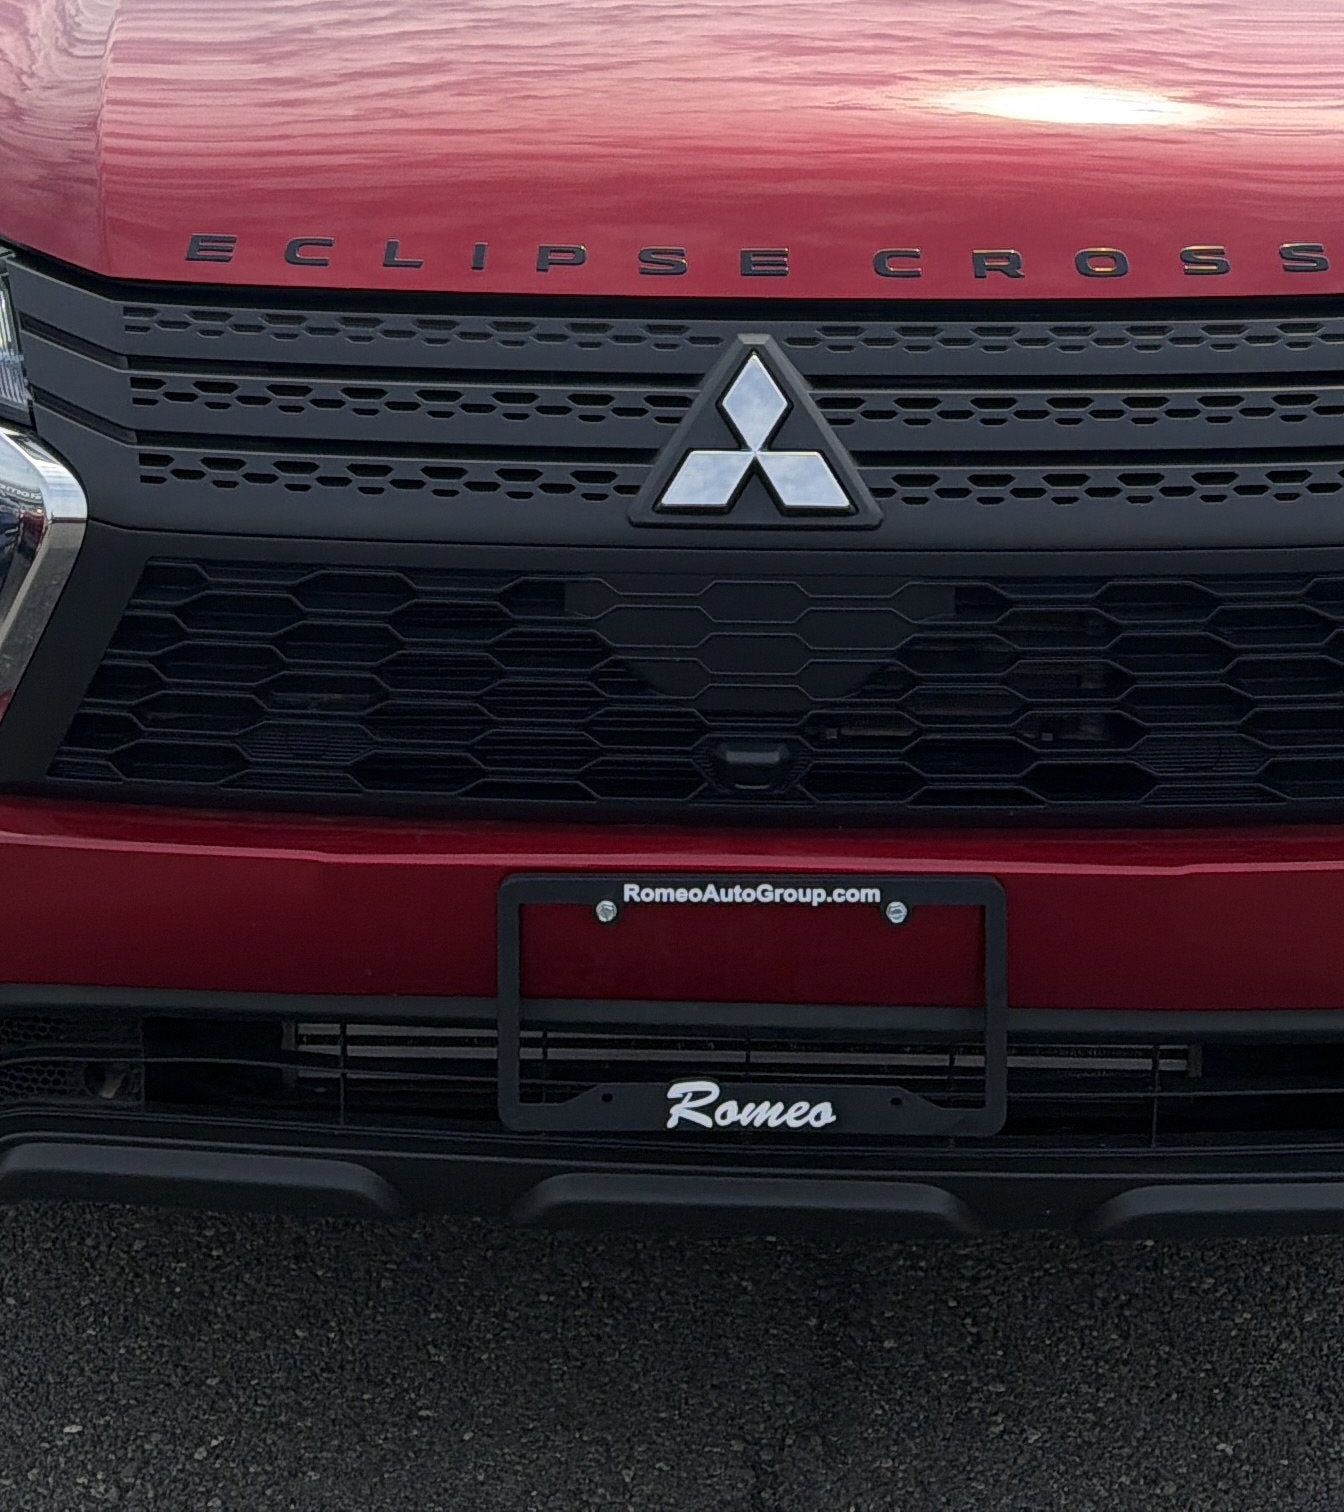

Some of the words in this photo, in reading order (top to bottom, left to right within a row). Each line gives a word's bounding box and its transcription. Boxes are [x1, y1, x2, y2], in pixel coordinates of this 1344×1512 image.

[185, 233, 790, 277] ECLIPSE
[873, 241, 1331, 279] CROSS
[623, 883, 881, 906] RomeoAutoGroup.com
[666, 1080, 837, 1129] Romeo
